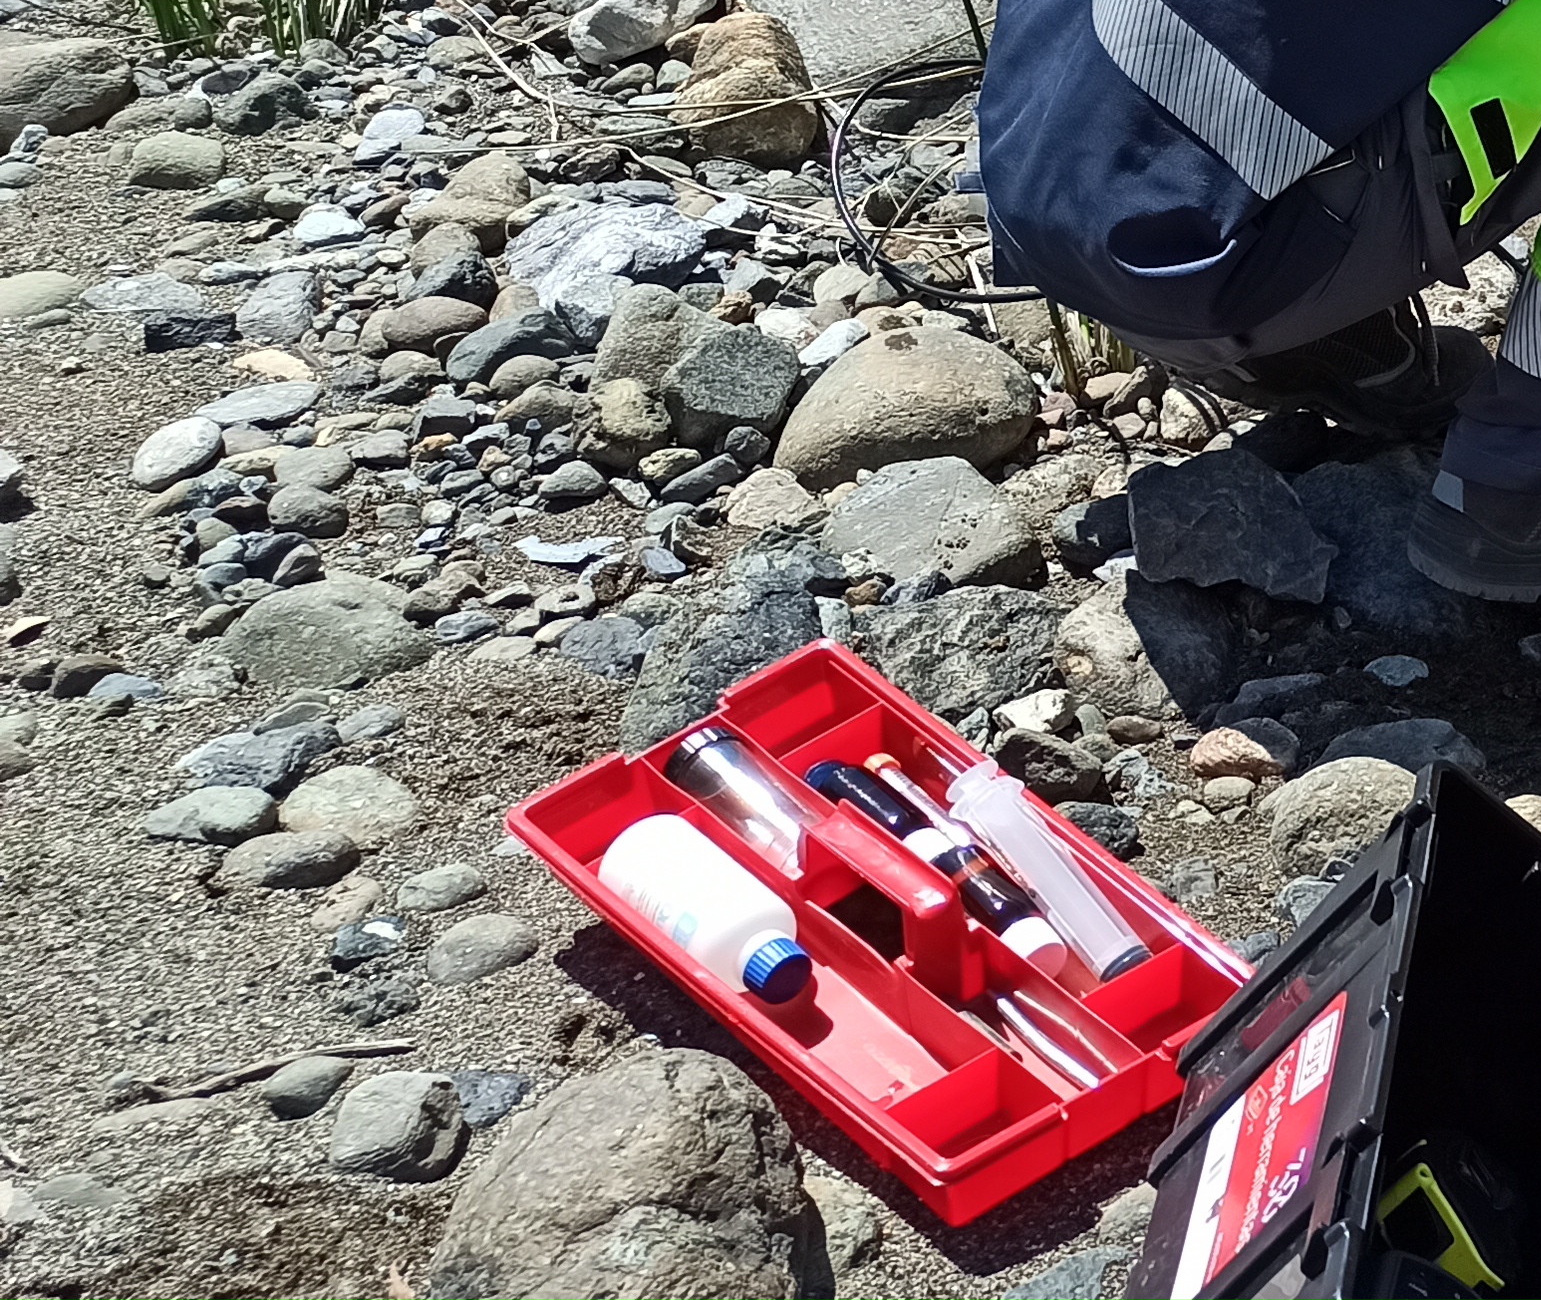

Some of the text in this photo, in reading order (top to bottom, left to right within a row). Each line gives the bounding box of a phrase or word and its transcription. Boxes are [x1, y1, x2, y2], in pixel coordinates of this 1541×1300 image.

[1304, 1017, 1334, 1081] Tayg
[1235, 1049, 1295, 1254] Caja de herramientas
